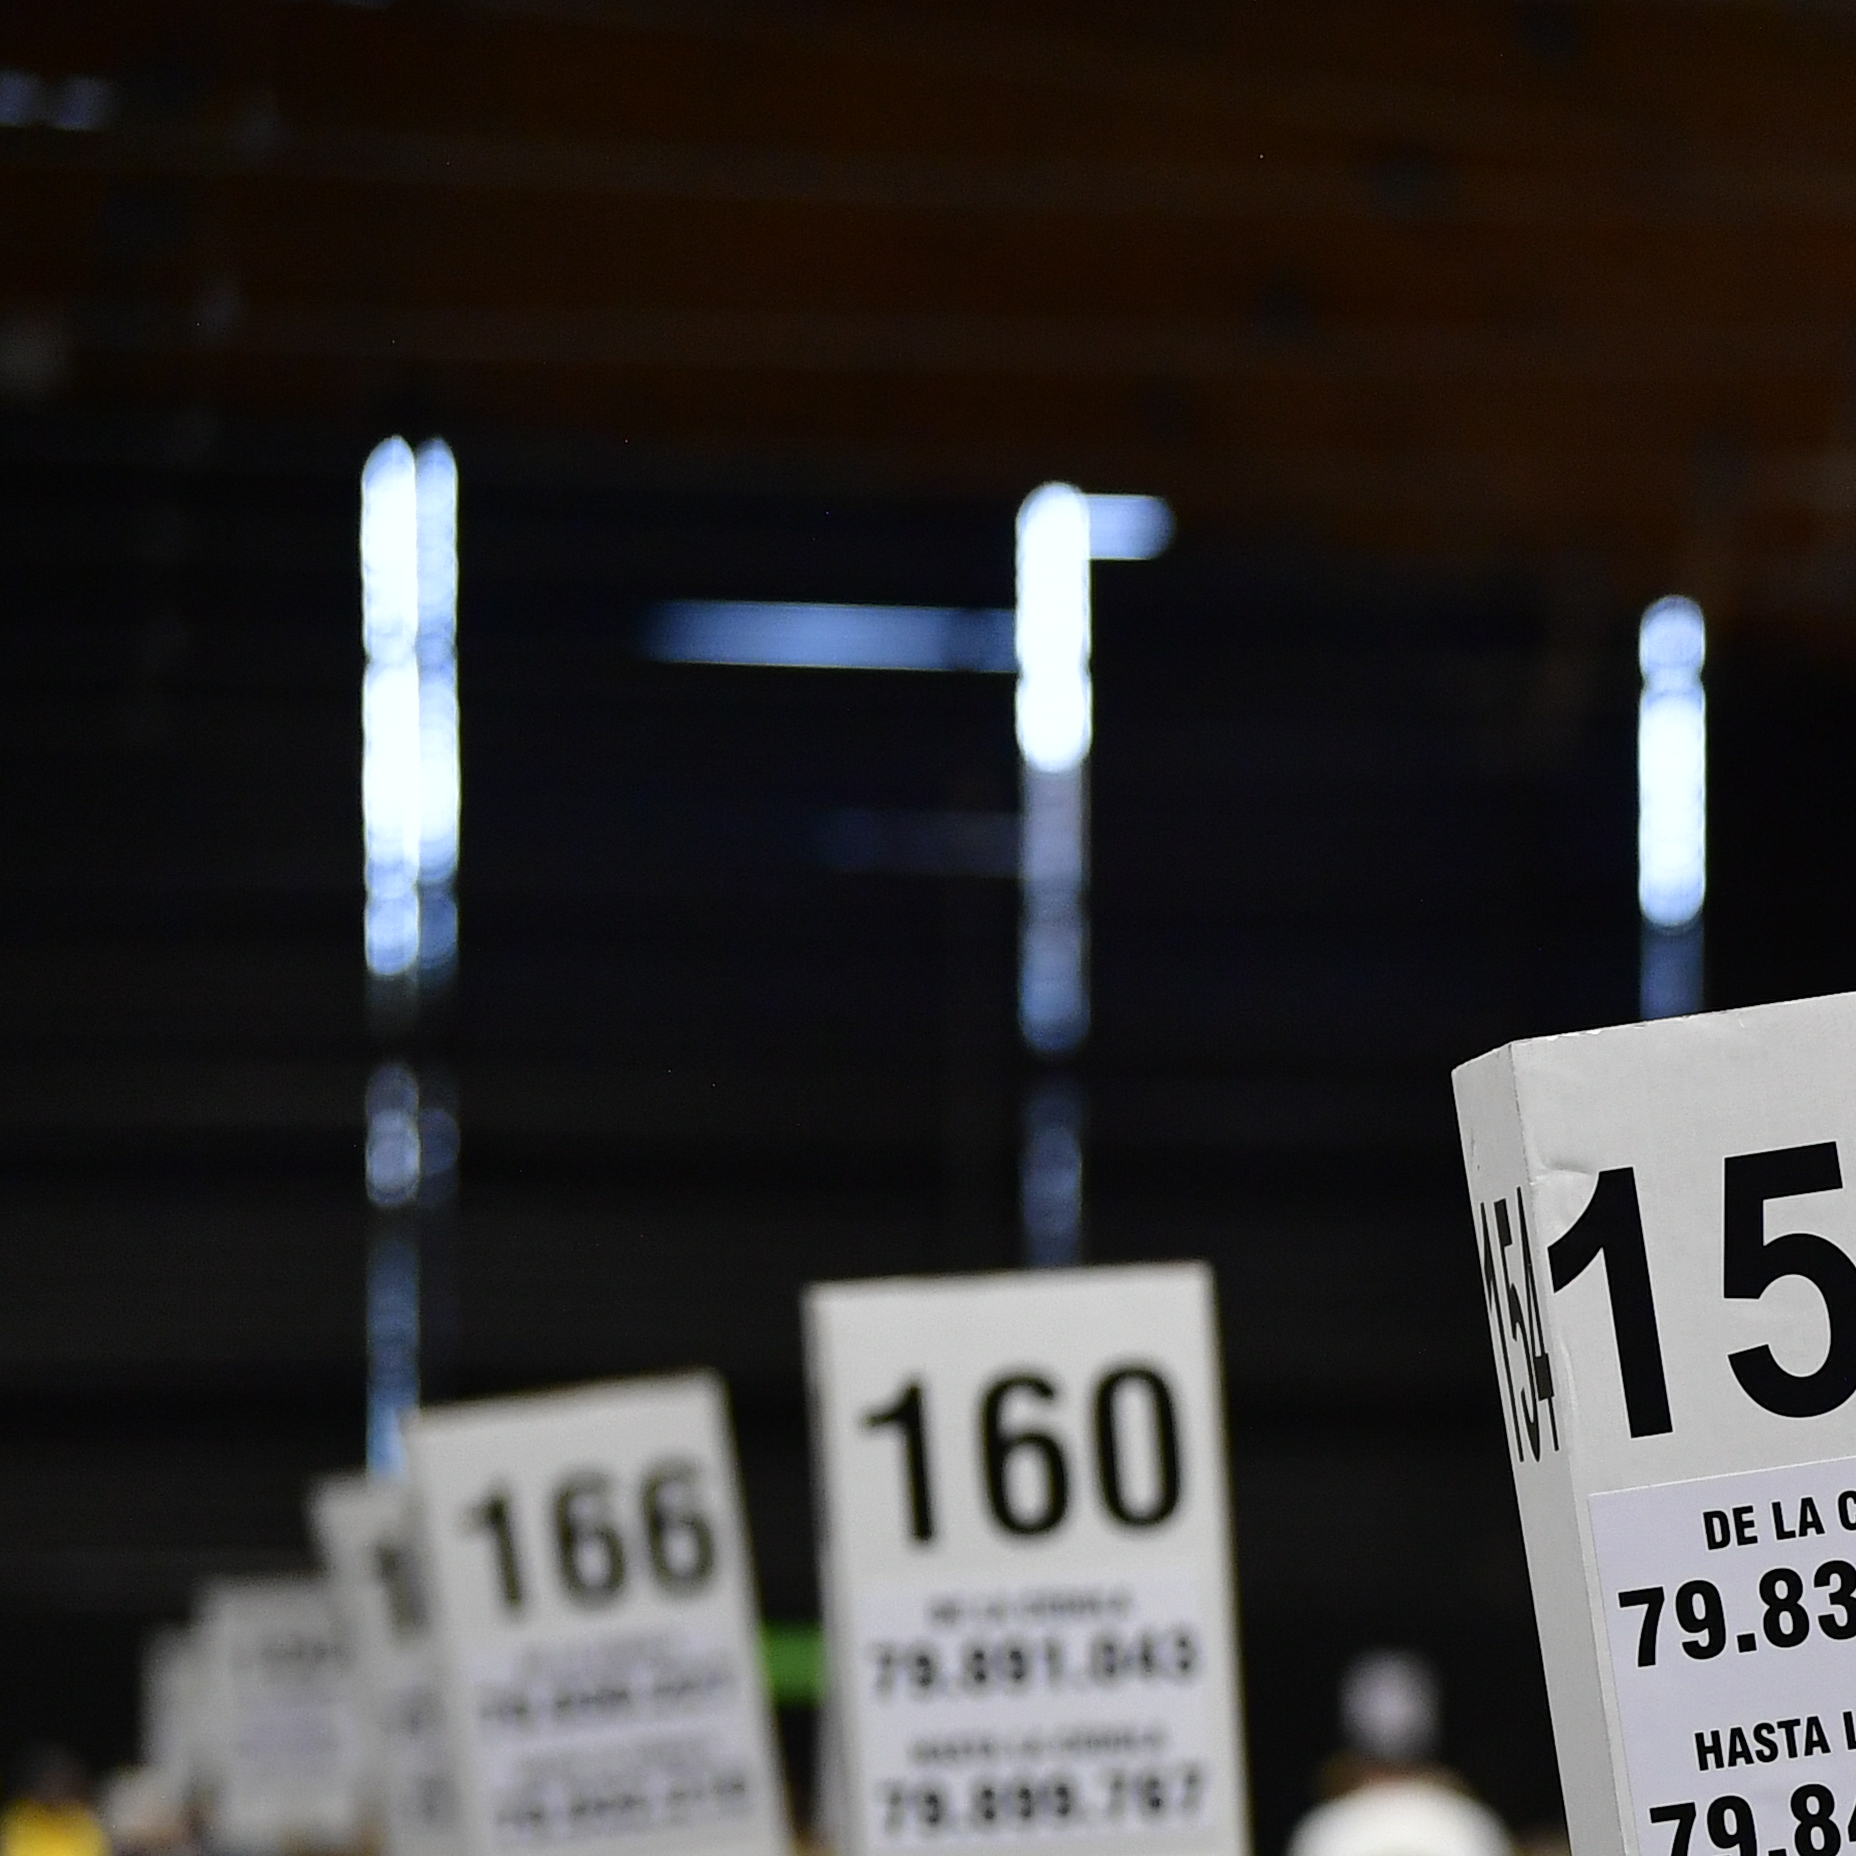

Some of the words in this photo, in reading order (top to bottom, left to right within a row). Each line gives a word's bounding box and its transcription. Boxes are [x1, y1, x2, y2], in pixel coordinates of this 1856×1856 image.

[1480, 1186, 1559, 1463] 154
[462, 1448, 723, 1616] 166
[862, 1358, 1187, 1548] 160
[1703, 1505, 1757, 1549] DE
[1772, 1497, 1824, 1539] LA
[1695, 1716, 1830, 1771] HASTA
